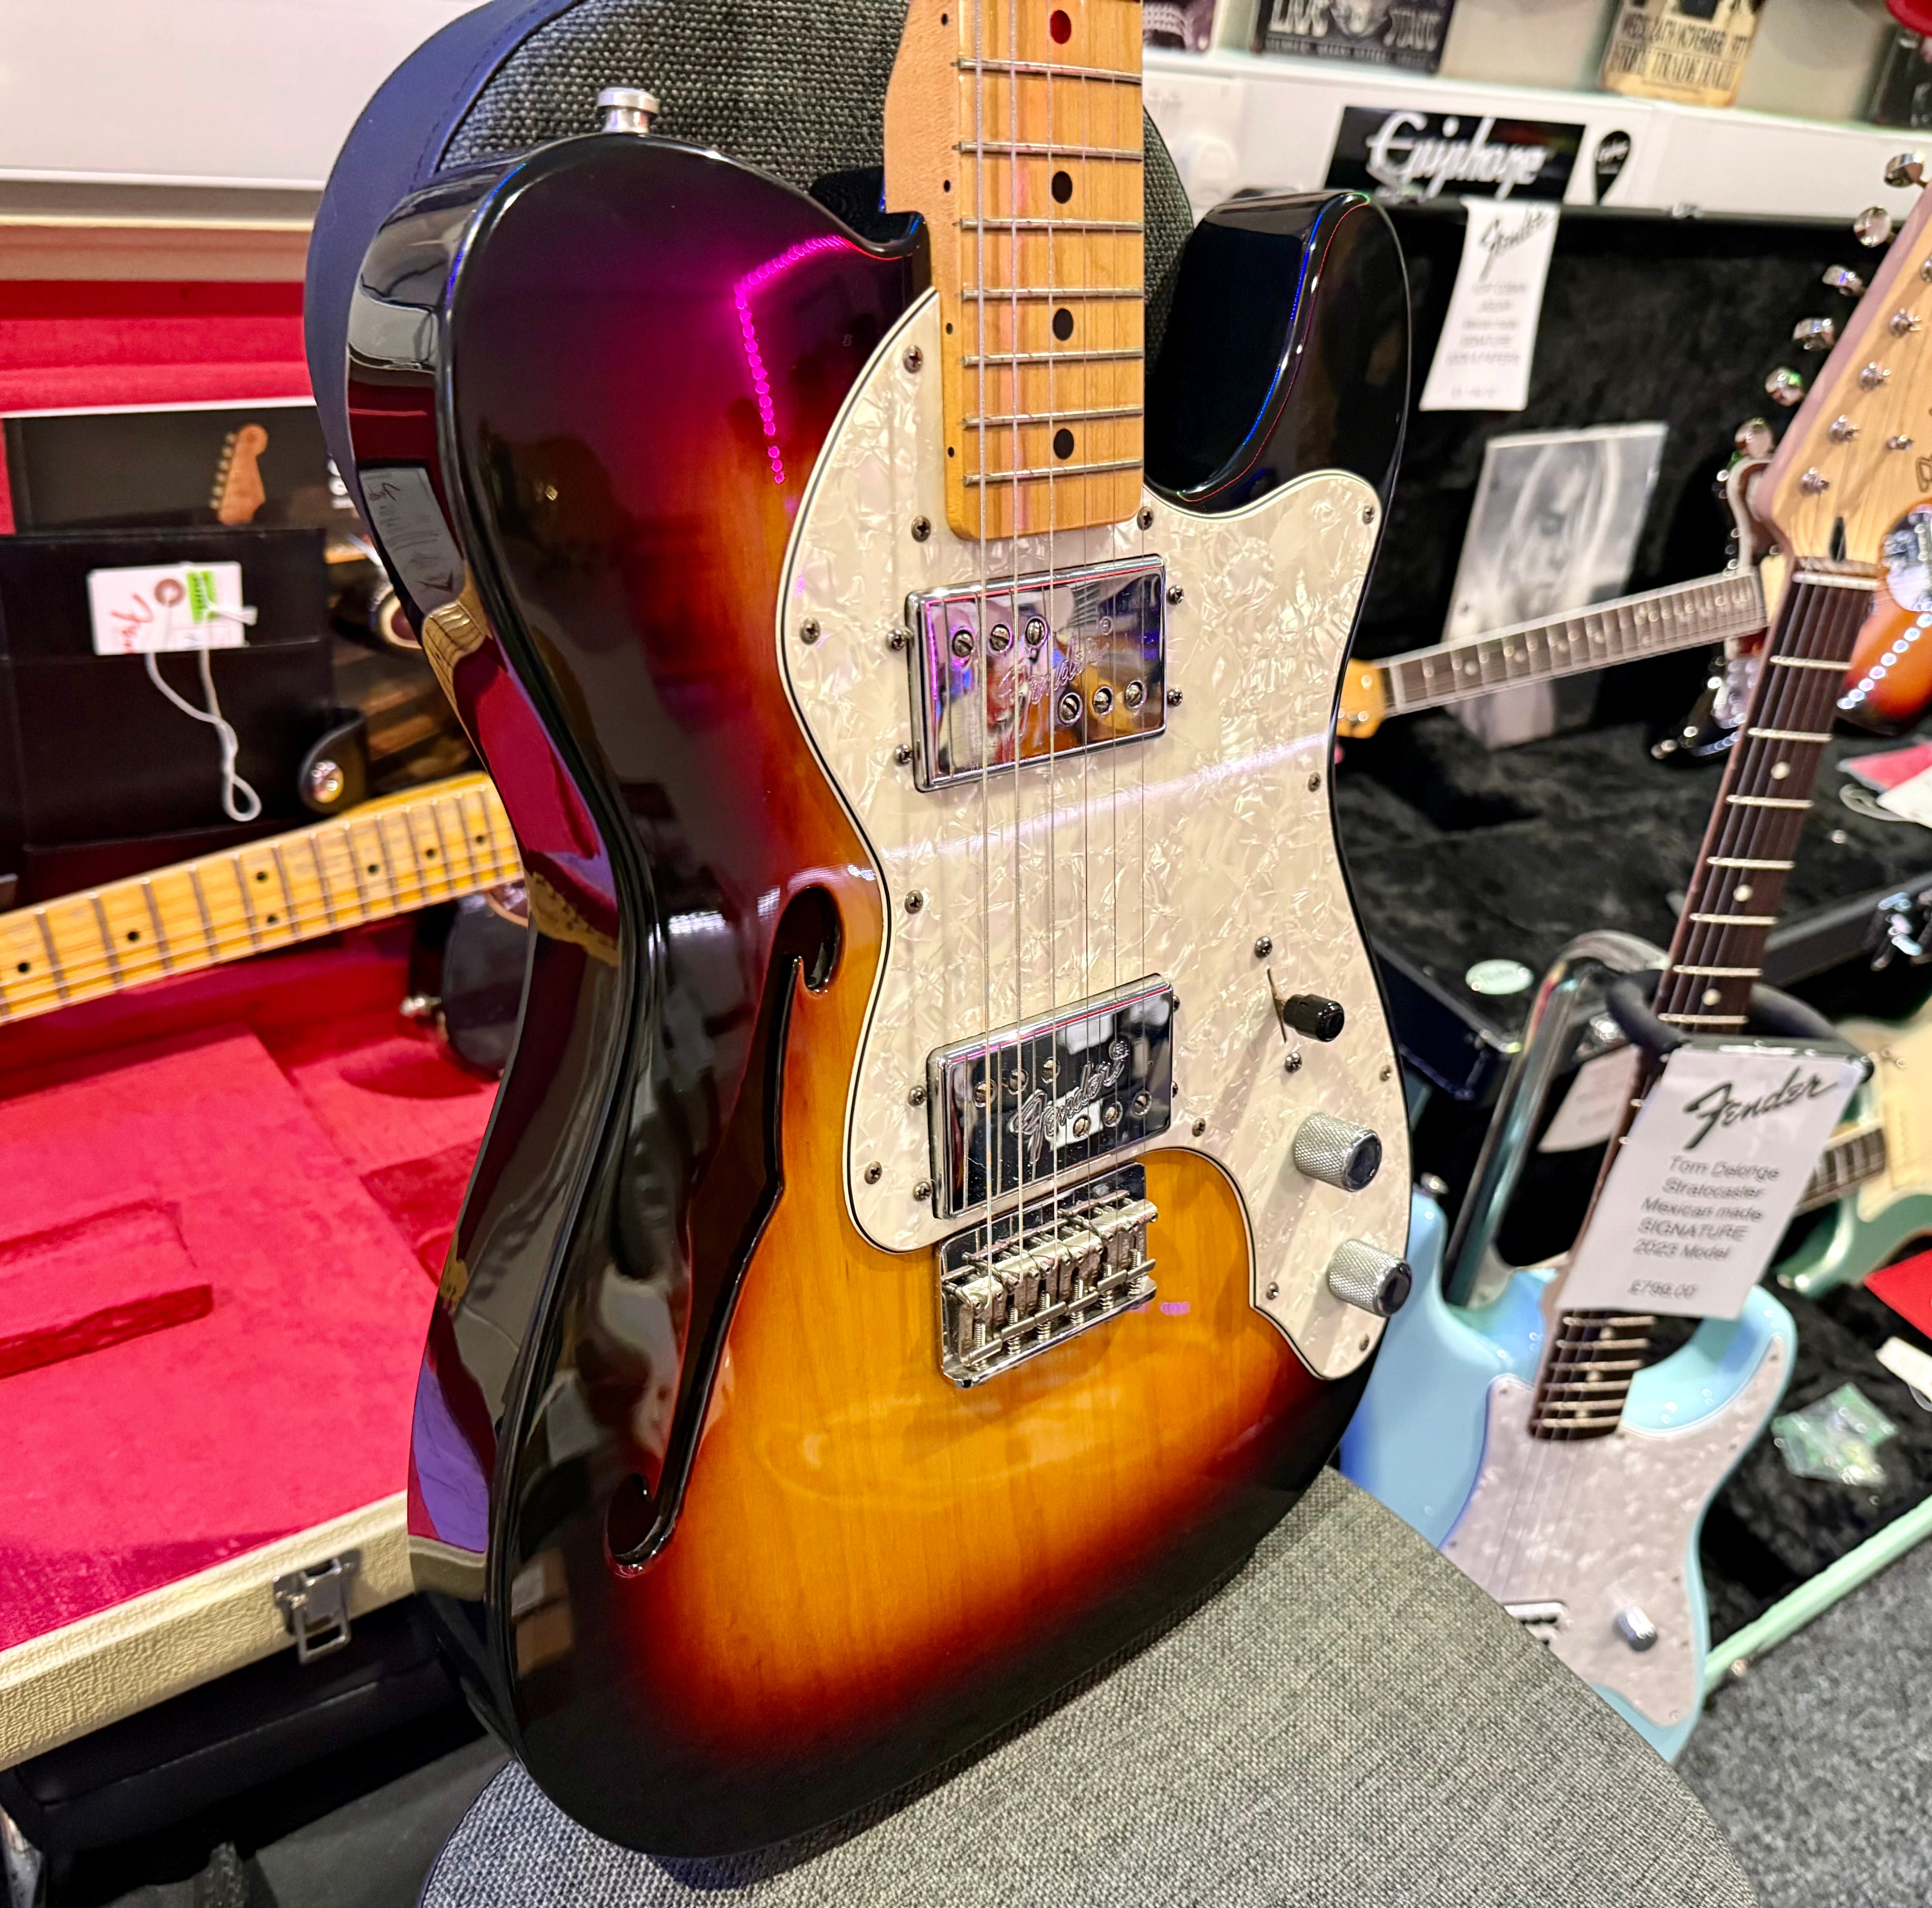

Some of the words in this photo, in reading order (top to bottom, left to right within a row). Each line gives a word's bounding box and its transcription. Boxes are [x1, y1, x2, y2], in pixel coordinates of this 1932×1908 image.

[1365, 110, 1550, 201] Epiphone
[1009, 1059, 1128, 1165] Fender
[1683, 1066, 1838, 1151] Fender
[1670, 1155, 1708, 1175] Tom
[1662, 1177, 1764, 1199] Stratocaster
[1641, 1196, 1714, 1219] Mexican
[1715, 1206, 1763, 1222] made
[1638, 1217, 1749, 1242] SIGNATURE
[1633, 1238, 1679, 1258] 2023
[1680, 1243, 1731, 1261] Model
